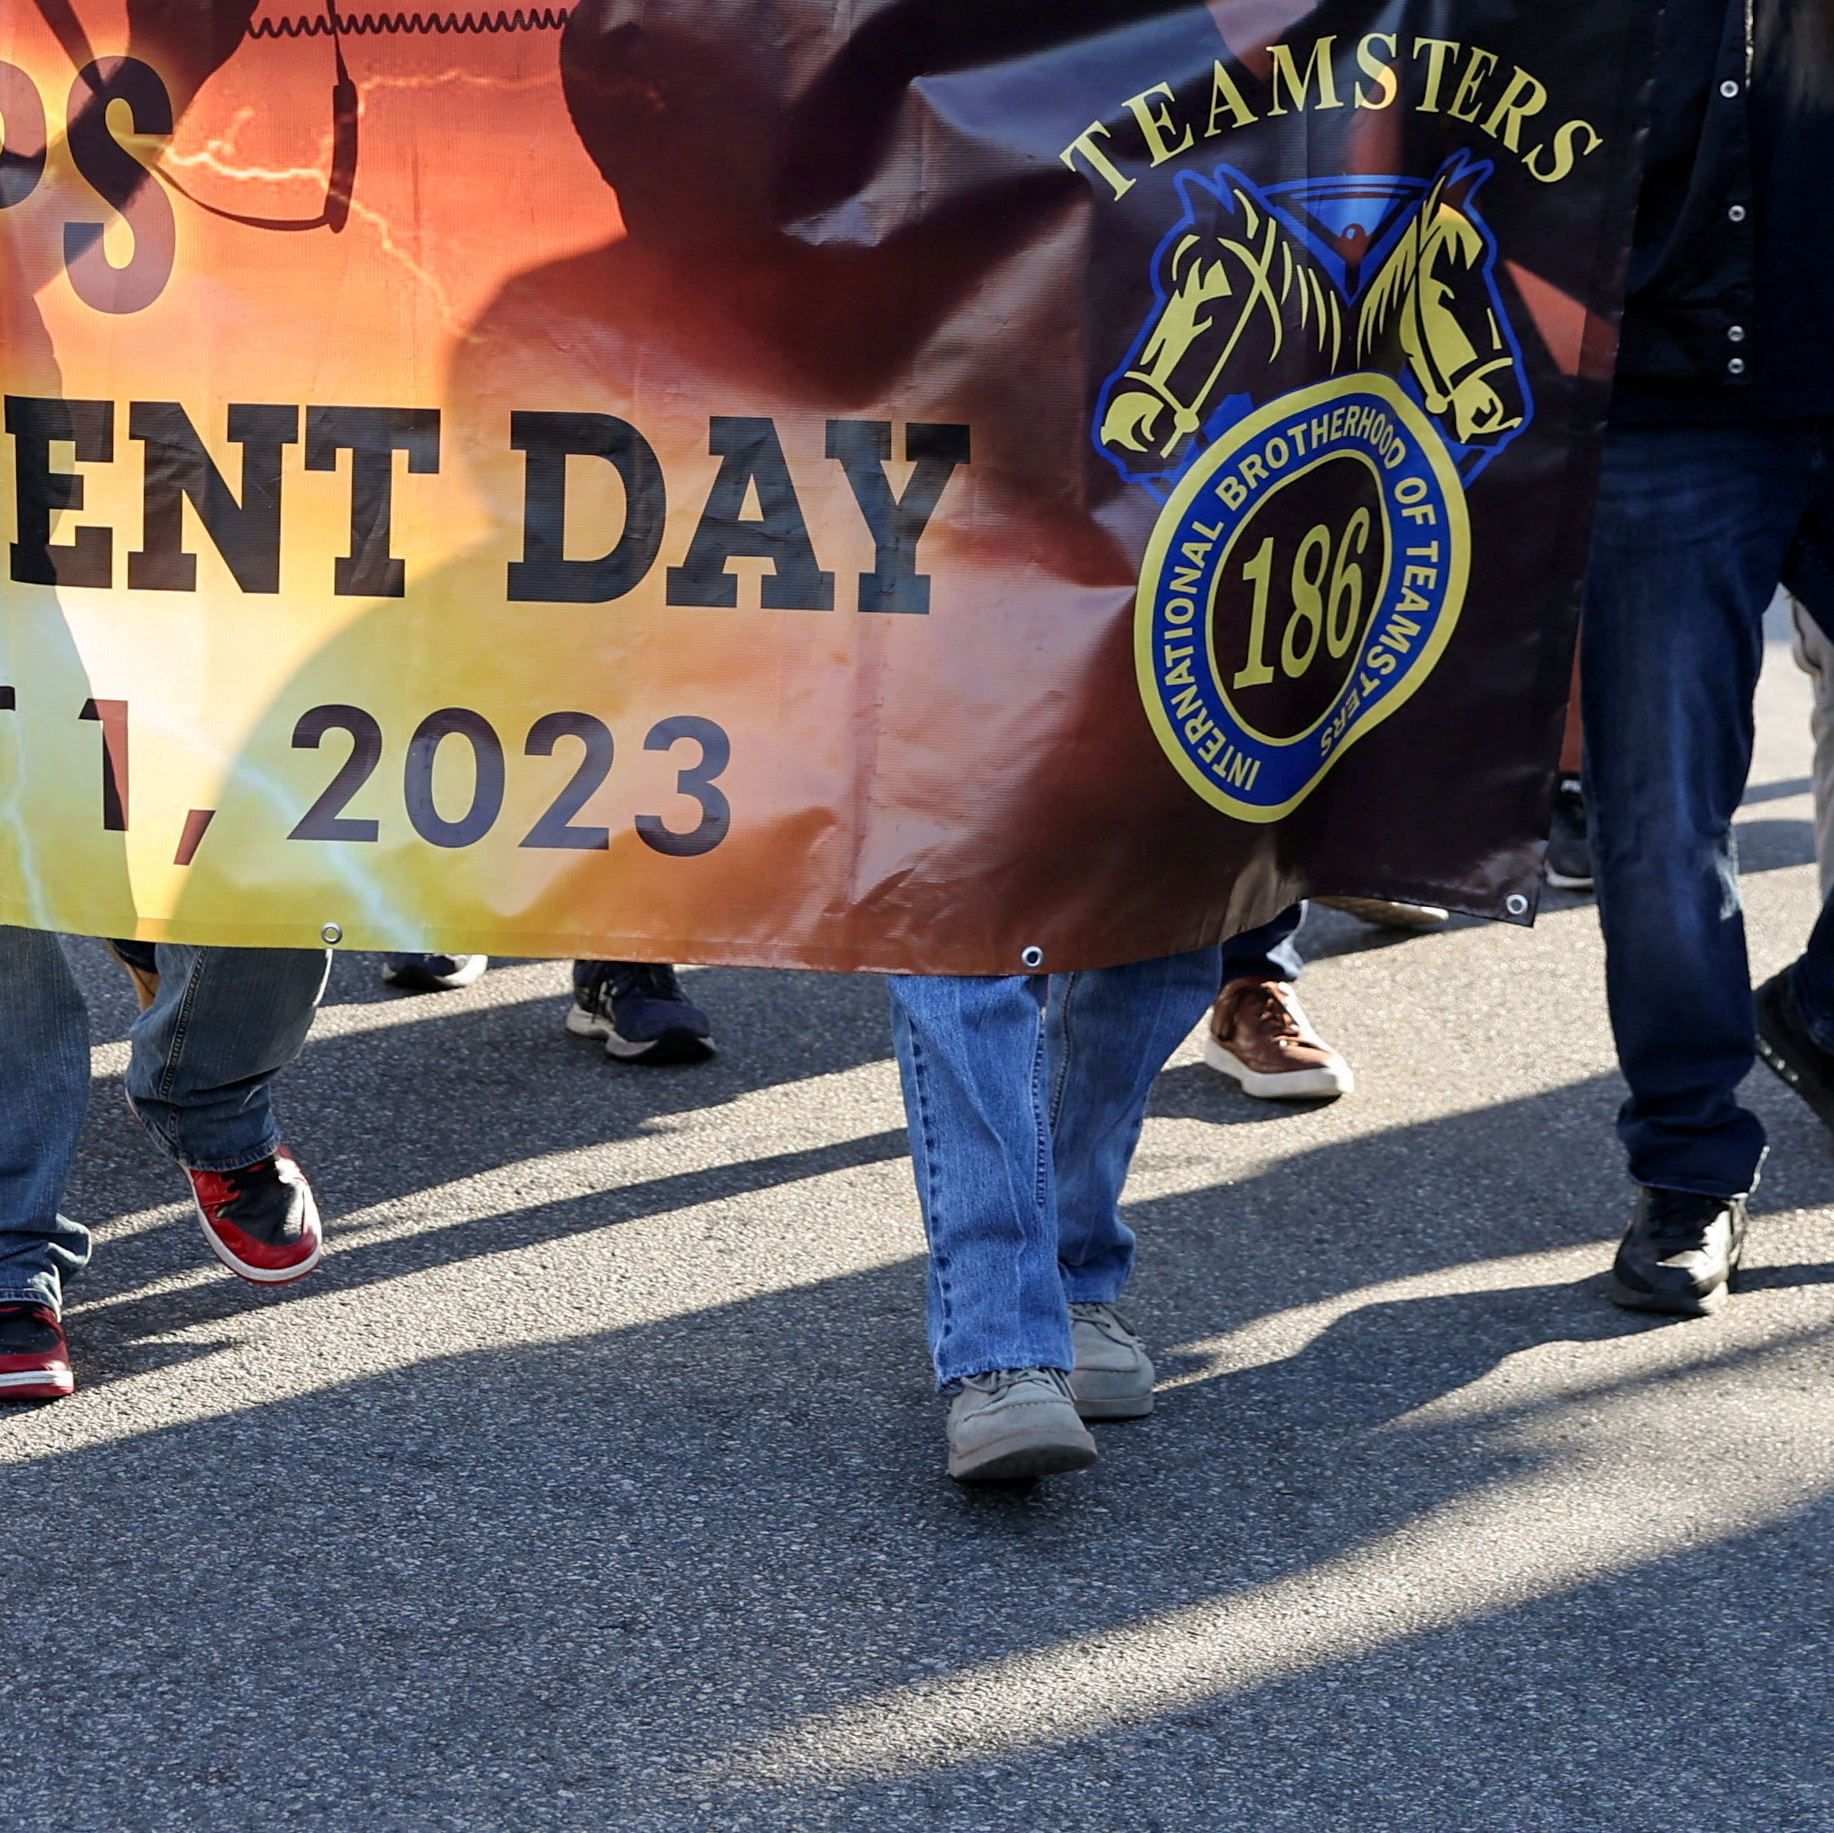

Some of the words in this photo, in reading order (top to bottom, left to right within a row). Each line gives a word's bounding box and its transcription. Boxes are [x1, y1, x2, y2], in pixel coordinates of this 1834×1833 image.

[1058, 31, 1603, 204] TEAMSTERS
[506, 410, 971, 615] DAY
[1216, 405, 1403, 516] BROTHERHOOD
[1399, 481, 1436, 526] OF
[1164, 517, 1261, 792] INTERNATIONAL
[1233, 506, 1371, 690] 186
[1320, 540, 1438, 759] TEAMSTERS
[79, 698, 216, 865] 1,
[286, 703, 732, 857] 2023
